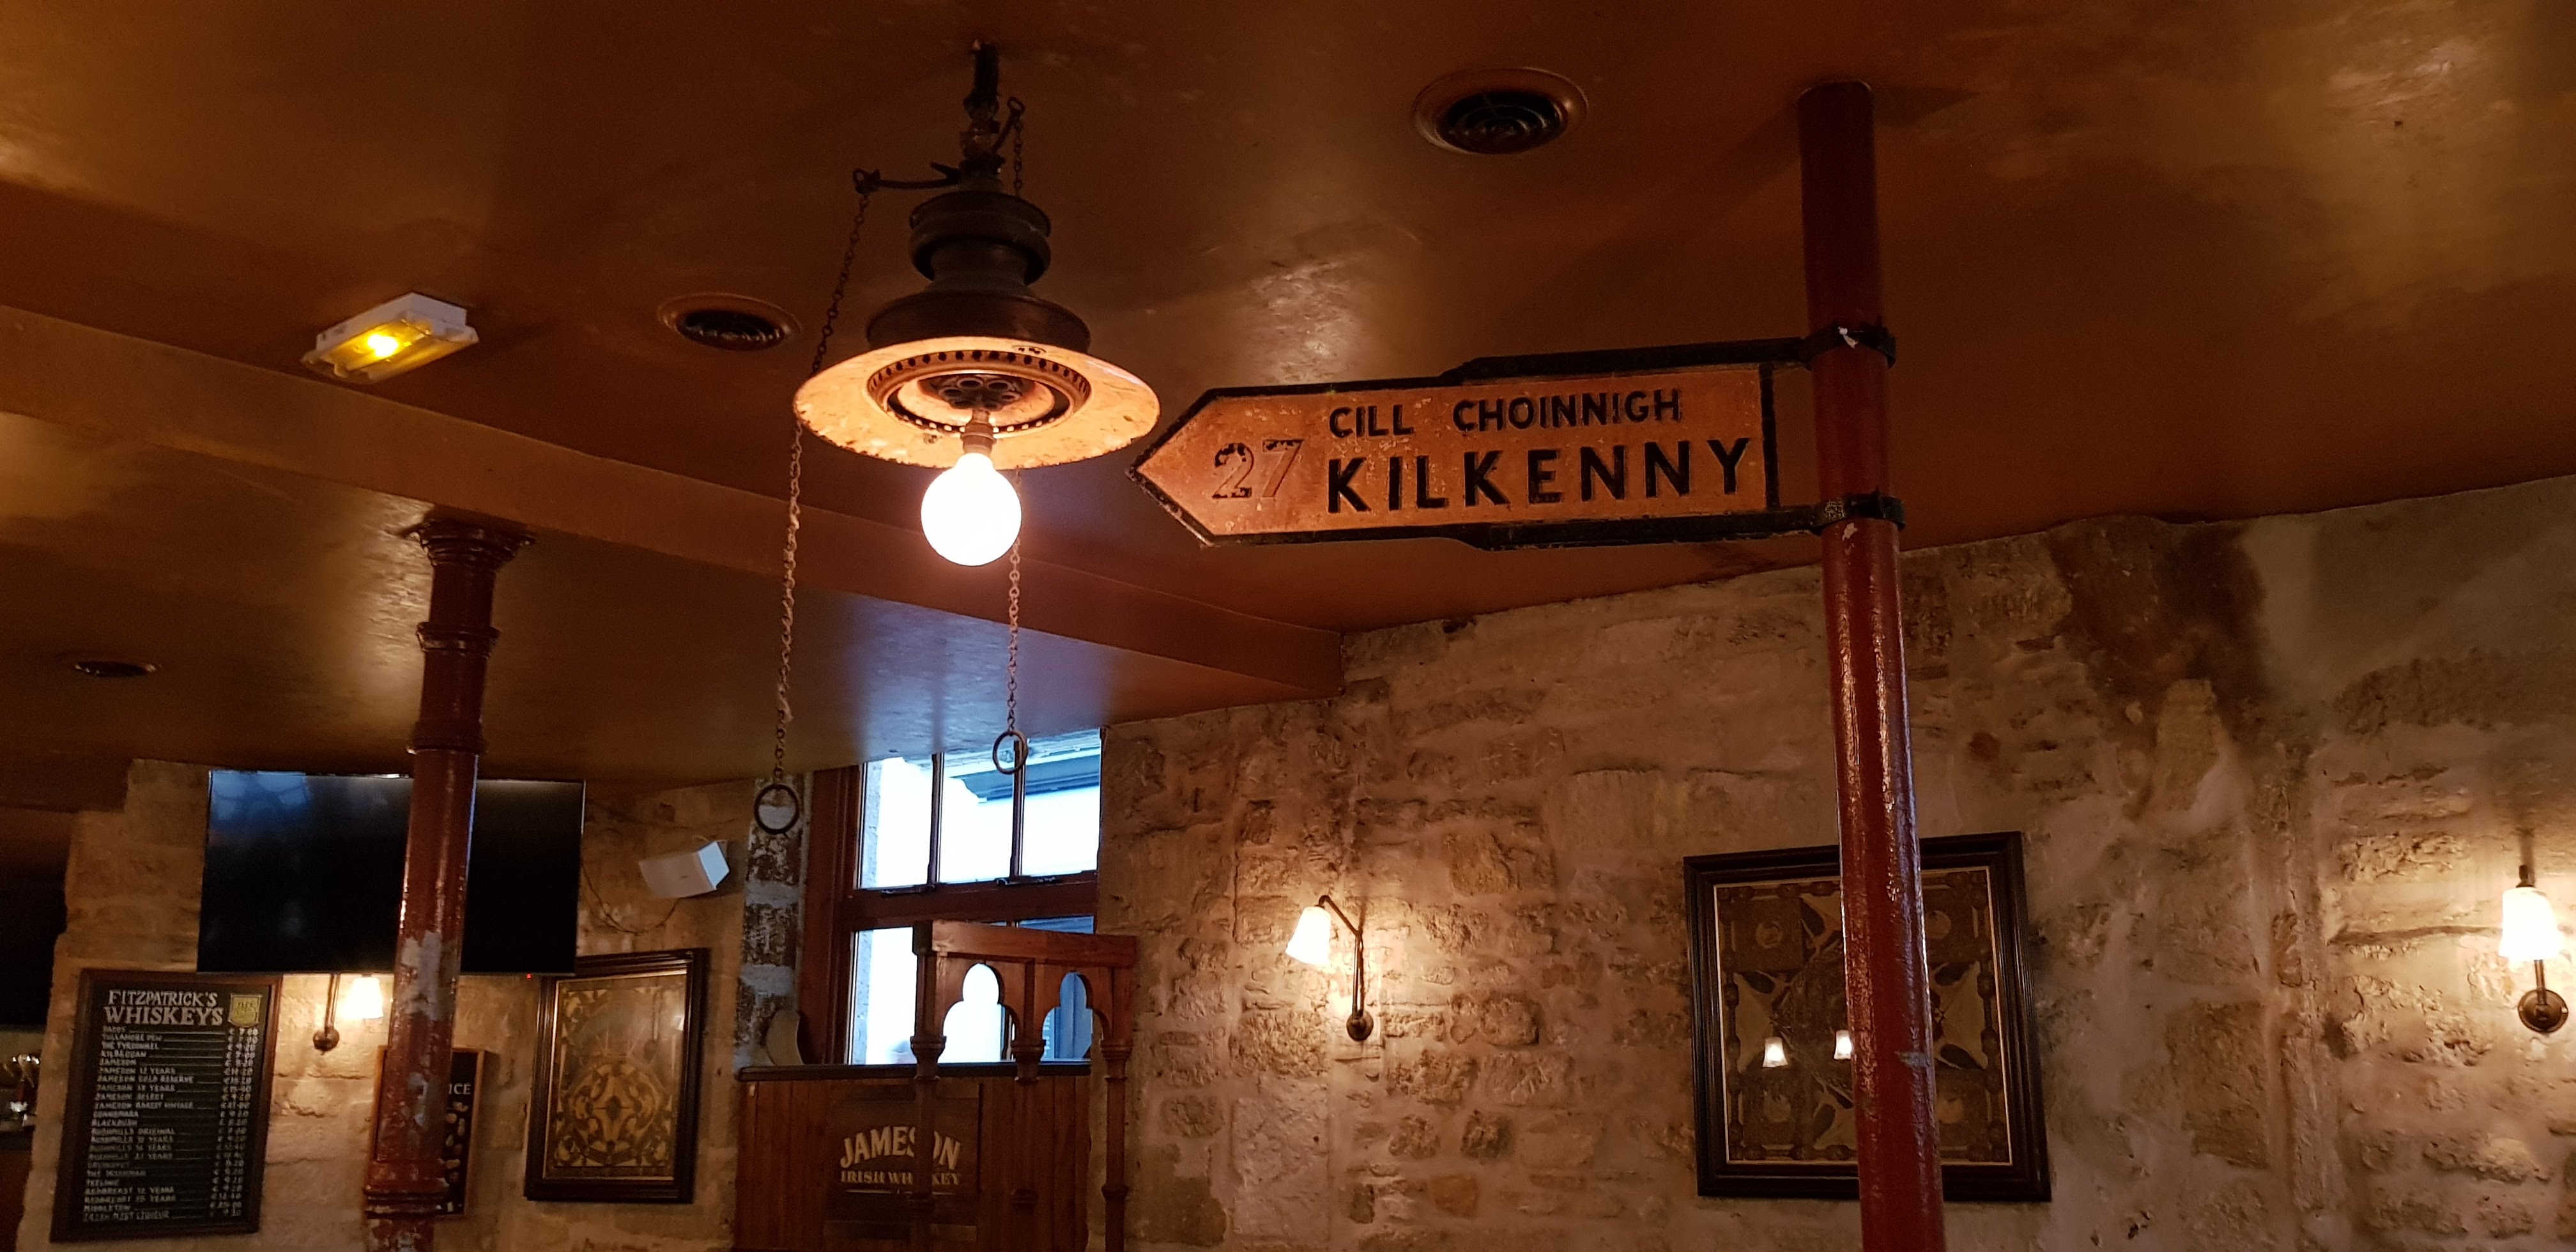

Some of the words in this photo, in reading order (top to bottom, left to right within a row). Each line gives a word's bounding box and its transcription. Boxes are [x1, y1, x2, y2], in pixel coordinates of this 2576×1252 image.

[1329, 404, 1414, 439] CILL
[1452, 388, 1681, 432] CHOINNIGH
[1212, 438, 1305, 500] 27
[1328, 438, 1751, 514] KILKENNY
[107, 989, 218, 1007] FITZPATRICK'S
[103, 1005, 224, 1026] WHISKEYS
[99, 1058, 137, 1066] JAMESON
[98, 1066, 136, 1074] JAMESON
[96, 1074, 135, 1083] JAMESON
[96, 1083, 133, 1092] JAMESON
[94, 1092, 133, 1101] JAMESON
[94, 1101, 133, 1110] JAMESON
[148, 1135, 174, 1143] YEARS
[148, 1143, 173, 1152] YEARS
[148, 1152, 174, 1161] YEARS
[840, 1170, 885, 1184] IRISH
[887, 1171, 960, 1186] WHKEY
[149, 1186, 174, 1195] YEARS
